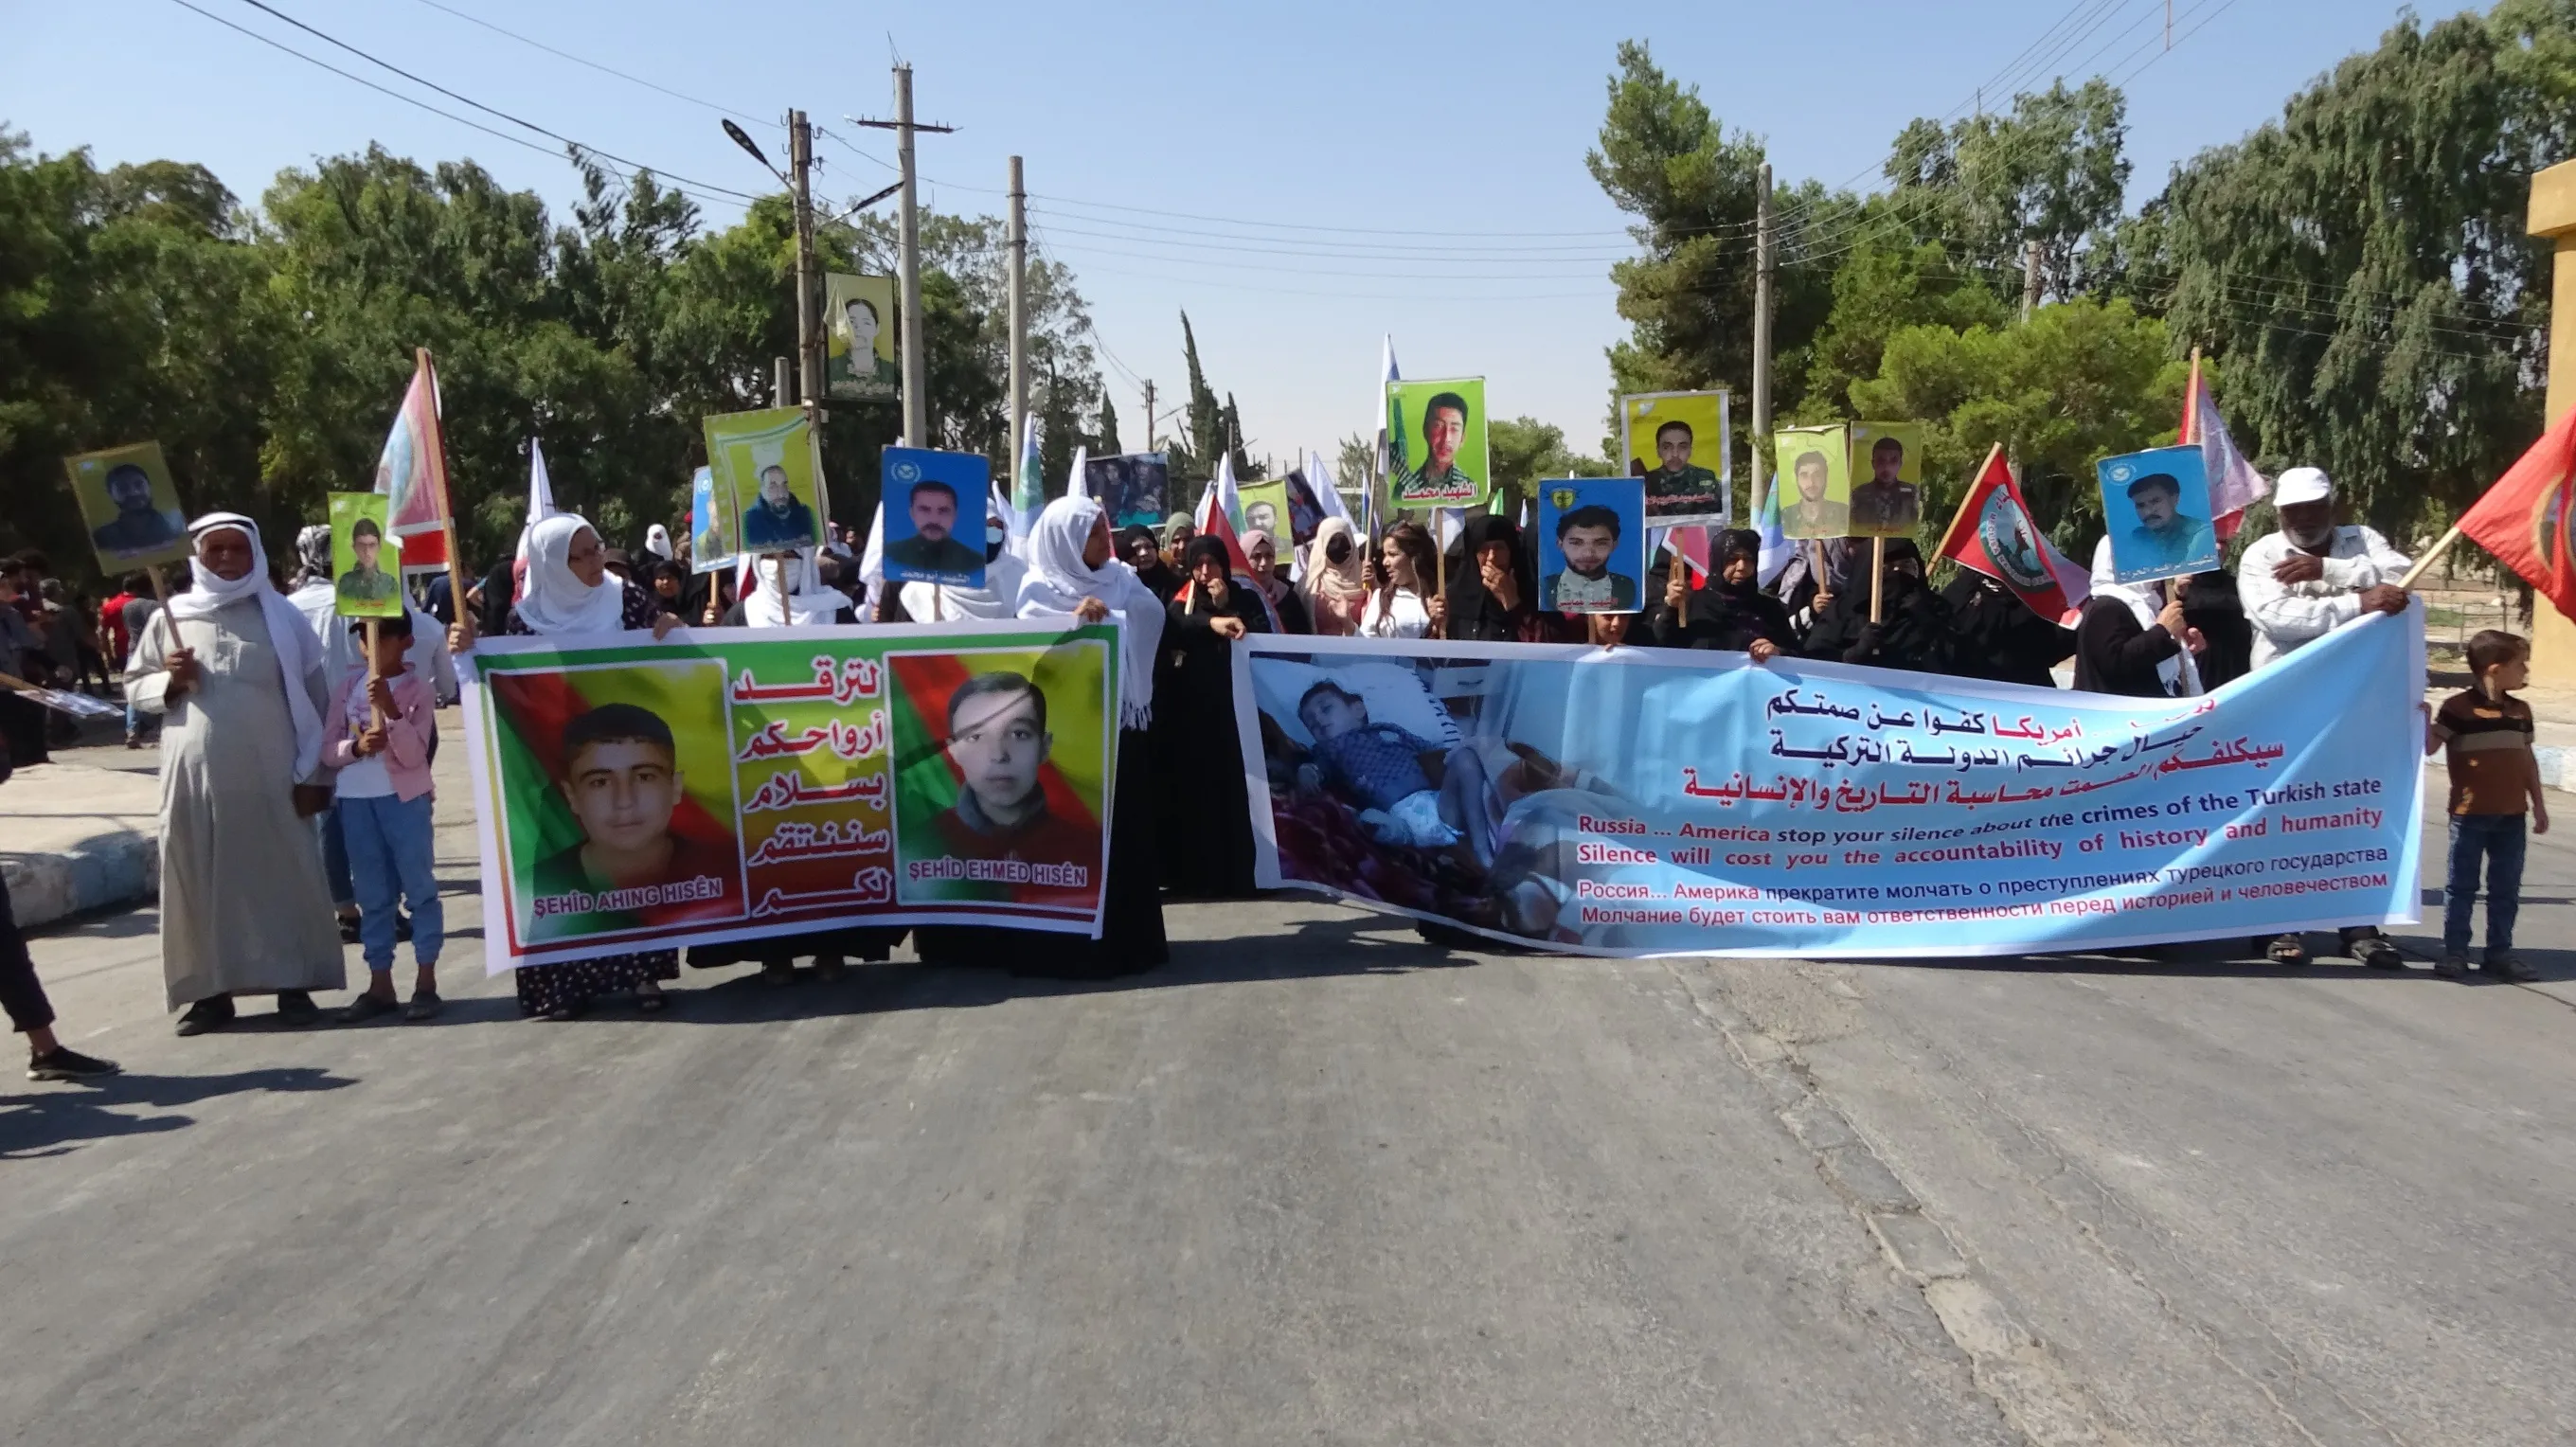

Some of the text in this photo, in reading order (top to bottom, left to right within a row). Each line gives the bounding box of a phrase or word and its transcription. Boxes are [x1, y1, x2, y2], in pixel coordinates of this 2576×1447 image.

[1442, 482, 1476, 501] الشهيد
[733, 659, 880, 703] لترقد
[739, 710, 884, 759] أرواحكم
[1767, 688, 2083, 746] أمريكا كفوا عن صمتكم
[1769, 728, 1892, 769] التركية
[1900, 739, 2011, 773] الدولة
[2017, 745, 2120, 774] جرائم
[2154, 737, 2284, 780] سيكلفكم
[745, 772, 885, 811] بسلام
[1683, 767, 1831, 811] والإنسانية
[1835, 778, 1940, 813] التاريخ
[1945, 779, 2054, 811] محاسبة
[1579, 815, 1646, 834] Russia
[1678, 823, 1770, 842] America
[1777, 828, 1826, 846] stop
[1833, 831, 1885, 846] your
[1890, 827, 1965, 842] silence
[1970, 817, 2033, 835] about
[2039, 813, 2074, 828] the
[2082, 804, 2159, 824] crimes
[2166, 795, 2191, 815] of
[2198, 793, 2239, 812] the
[2245, 781, 2326, 806] Turkish
[2333, 777, 2382, 798] state
[752, 824, 888, 863] سننتقم
[1579, 807, 2384, 870] Silence will cost you the accountability of history and humanity
[597, 885, 660, 911] AHING
[663, 875, 723, 902] HISÊN
[754, 869, 889, 914] لكم
[968, 859, 1029, 882] EHMED
[1032, 861, 1087, 886] HISÊN
[1673, 884, 1760, 902] Америка
[1766, 886, 1880, 903] прекратите
[1887, 883, 1973, 899] молчать
[1978, 883, 1992, 895] о
[1998, 869, 2159, 895] преступлениях
[2166, 859, 2264, 884] турецкого
[2271, 848, 2388, 872] государства
[1583, 873, 2388, 927] Молчание будет стоить вам ответственности перед историей и человечеством
